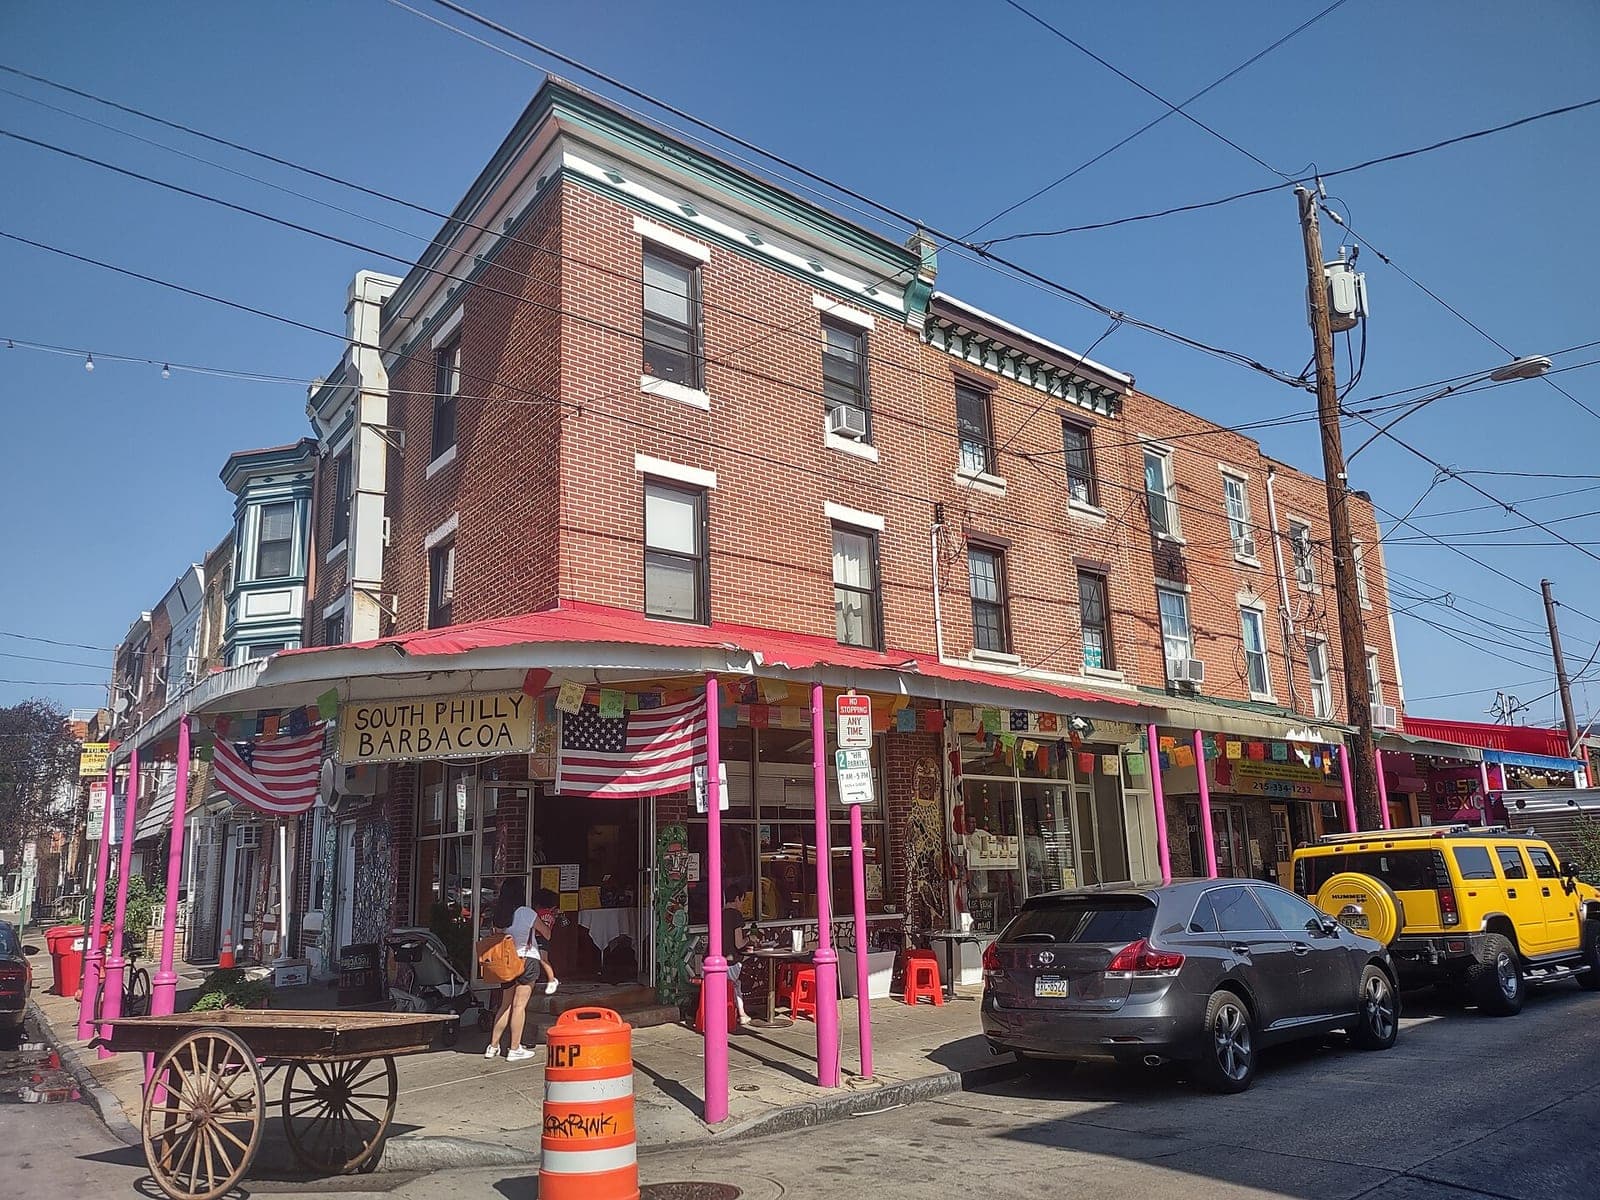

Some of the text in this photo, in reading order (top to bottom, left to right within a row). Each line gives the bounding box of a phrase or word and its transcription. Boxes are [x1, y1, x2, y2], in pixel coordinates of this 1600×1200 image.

[354, 695, 524, 731] SOUTH PHILLY
[840, 705, 868, 714] STOPPING
[847, 716, 861, 725] ANY
[847, 726, 863, 735] TIME
[358, 722, 513, 757] BARBACOA
[839, 753, 846, 768] 2
[1252, 781, 1312, 793] 215-334-1232
